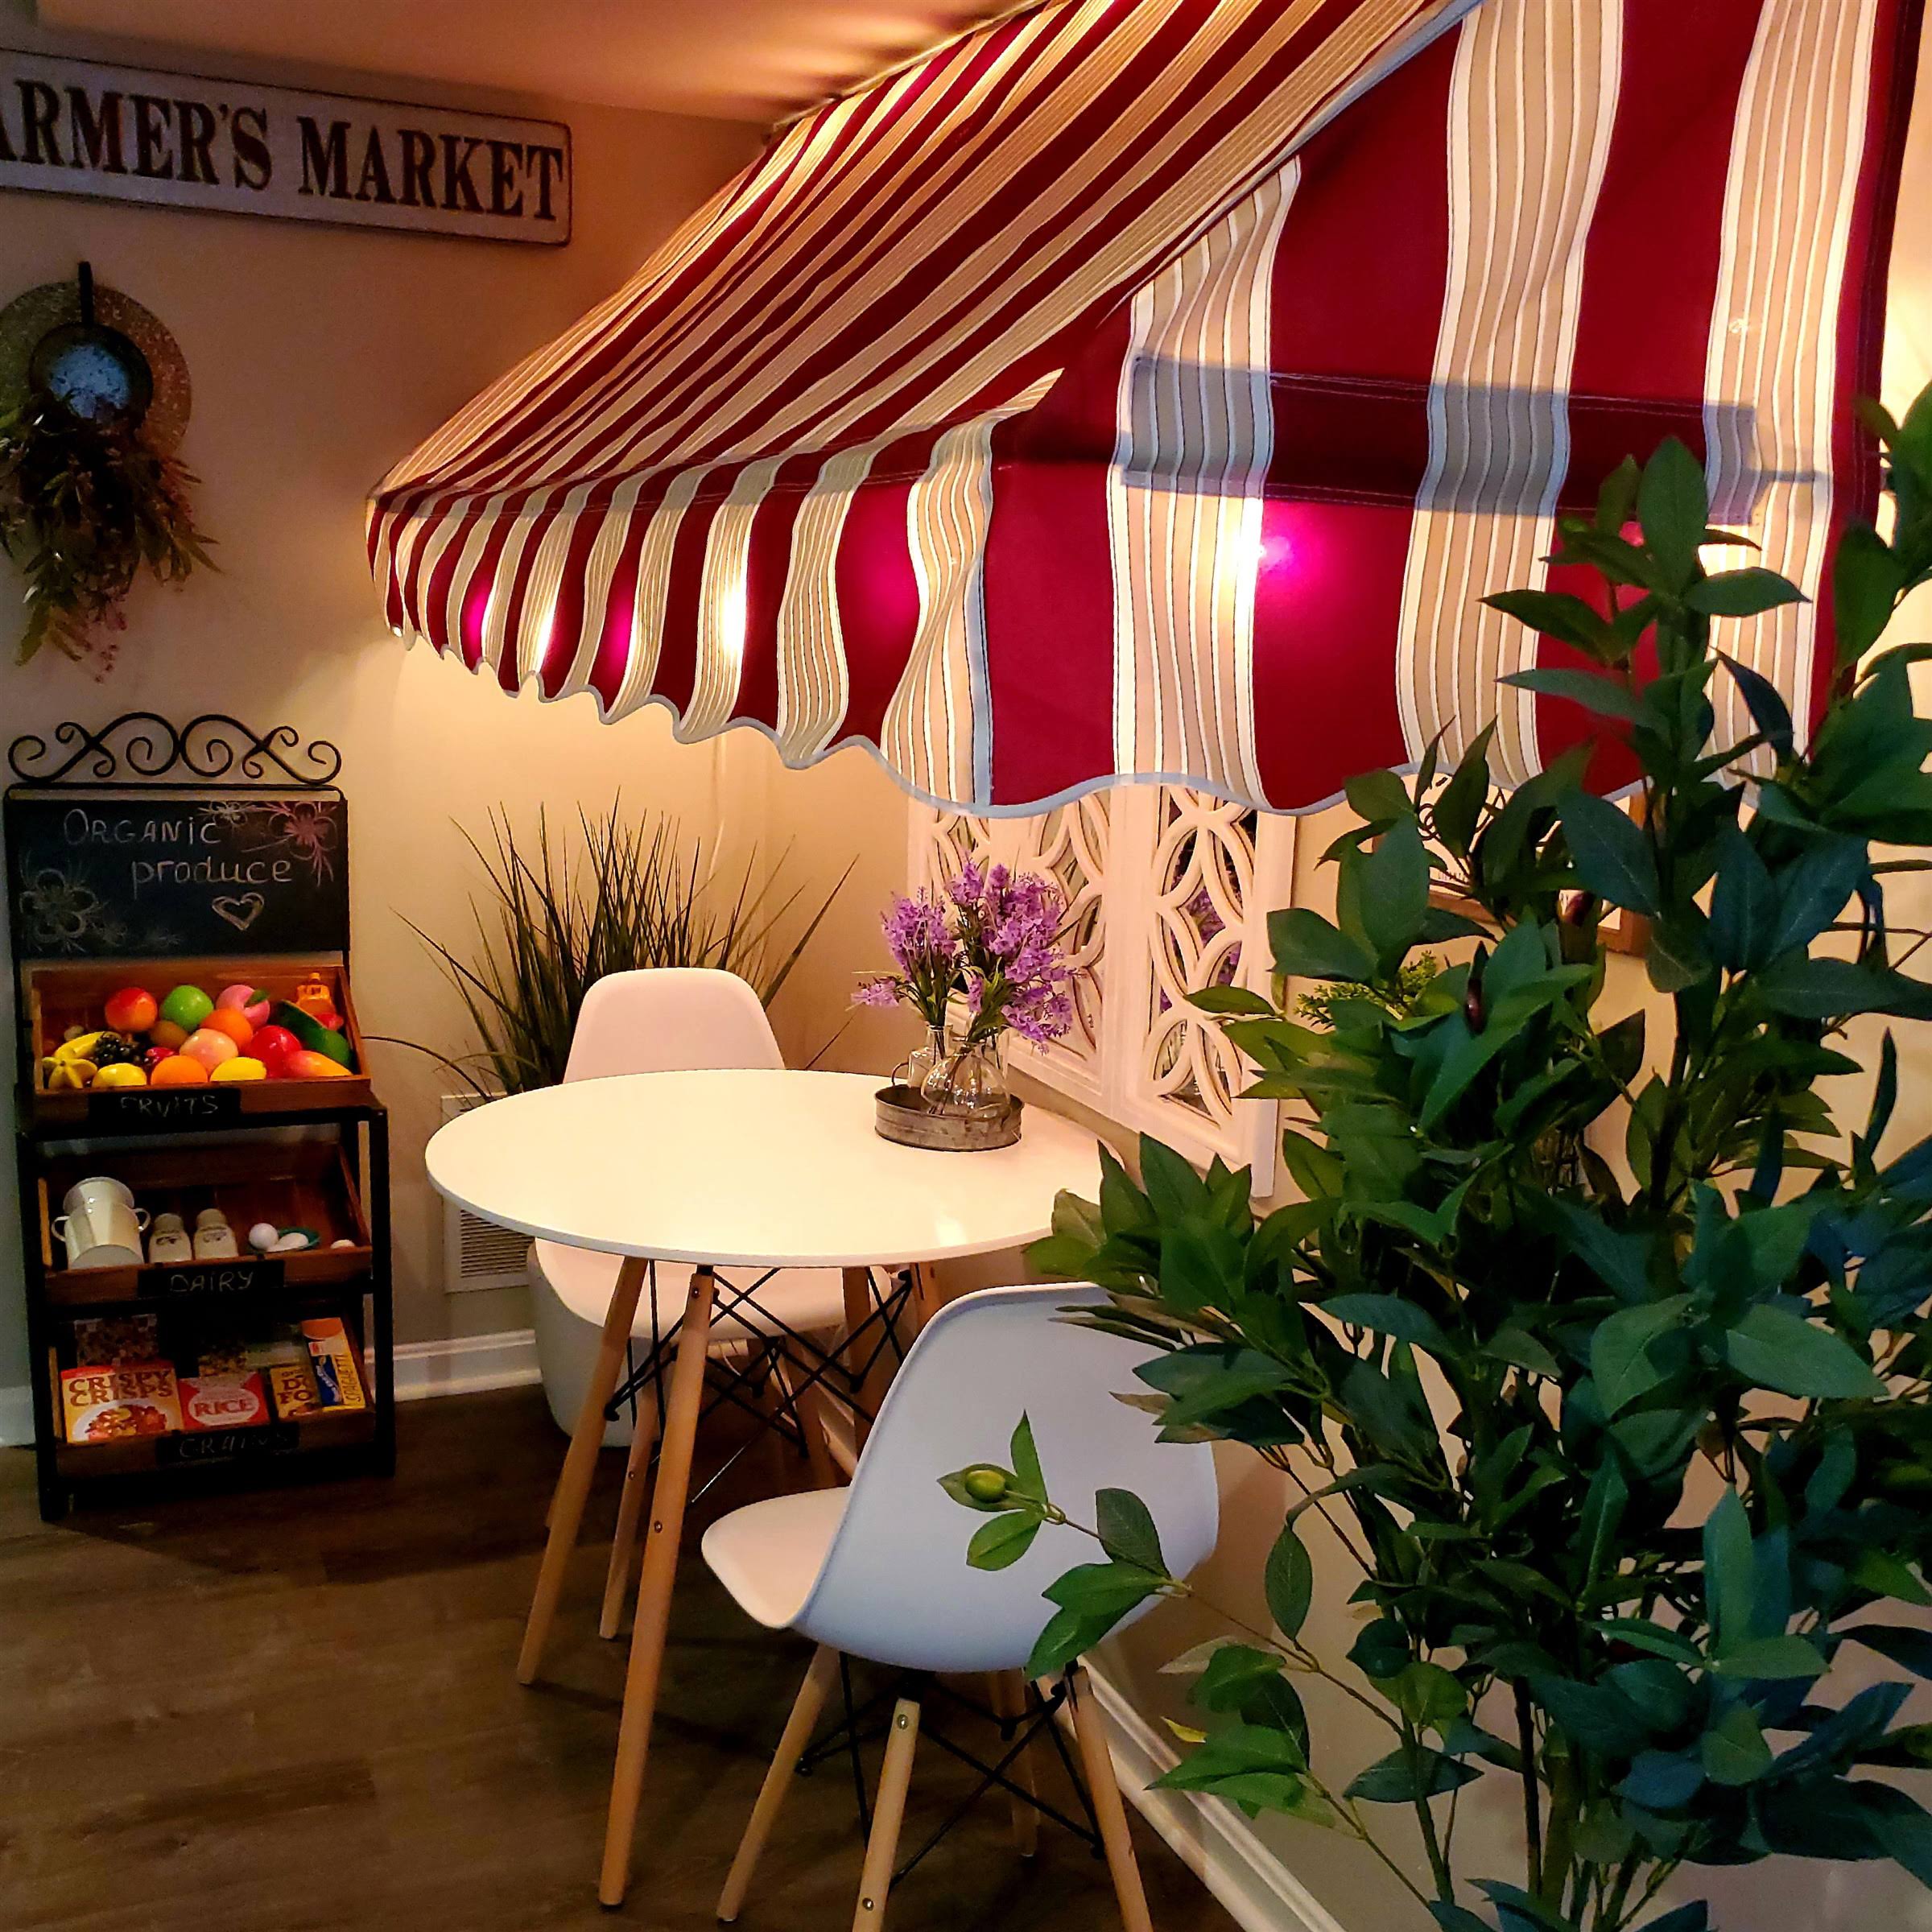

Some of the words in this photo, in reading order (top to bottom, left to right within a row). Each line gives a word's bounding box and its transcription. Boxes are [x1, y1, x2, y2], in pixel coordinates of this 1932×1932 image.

[297, 116, 562, 221] MARKET
[131, 857, 292, 899] produce
[68, 1370, 171, 1393] CRISPY
[70, 1384, 174, 1406] CRISPS
[194, 1399, 255, 1417] RICE
